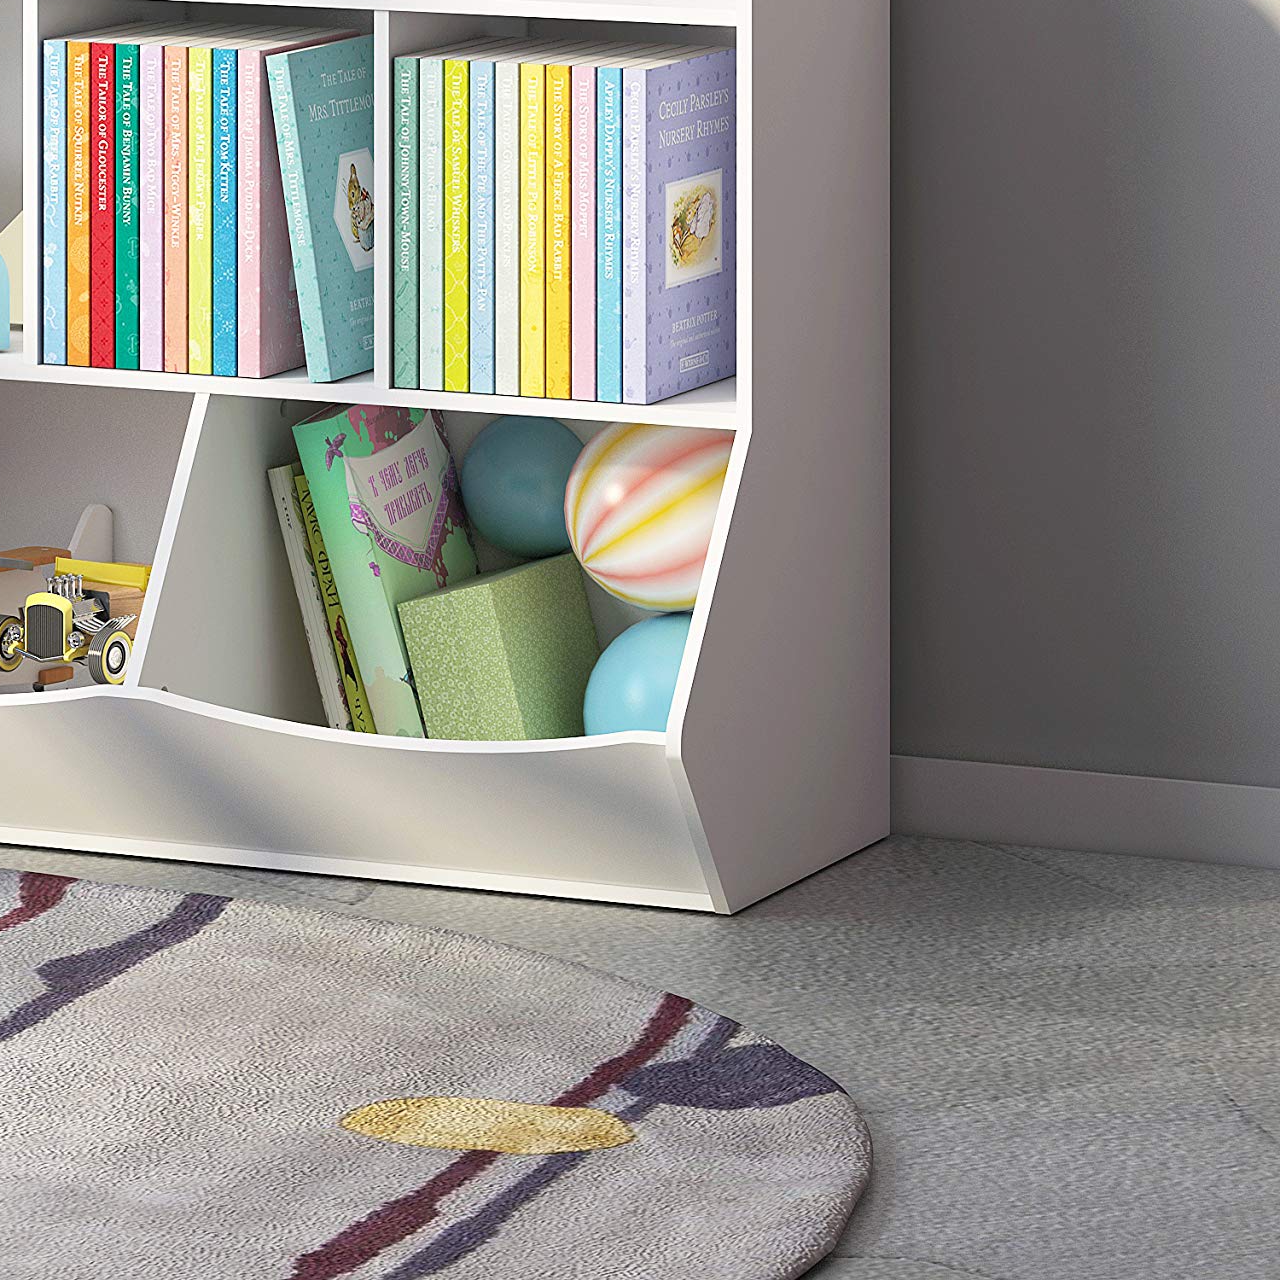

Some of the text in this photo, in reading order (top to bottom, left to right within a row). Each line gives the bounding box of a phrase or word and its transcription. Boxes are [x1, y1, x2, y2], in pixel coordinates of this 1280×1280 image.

[172, 60, 182, 84] THE
[401, 70, 412, 95] THE
[172, 85, 182, 114] TALE
[401, 97, 412, 125] TALE
[659, 99, 689, 120] CECILY
[99, 55, 109, 211] THE TAILOR OF GLOUCESTER
[172, 115, 181, 131] OF
[220, 63, 231, 204] THE TALE OF TOM KITTEN
[401, 127, 411, 142] OF
[659, 116, 729, 149] NURSERY RHYMES
[73, 54, 85, 226] THE TALE OF SQUIRREL NUTKIN
[121, 57, 133, 226] THE TALE OF BENJAMIN BUNNY
[172, 132, 182, 161] MRS.
[399, 142, 412, 189] JOHNNY
